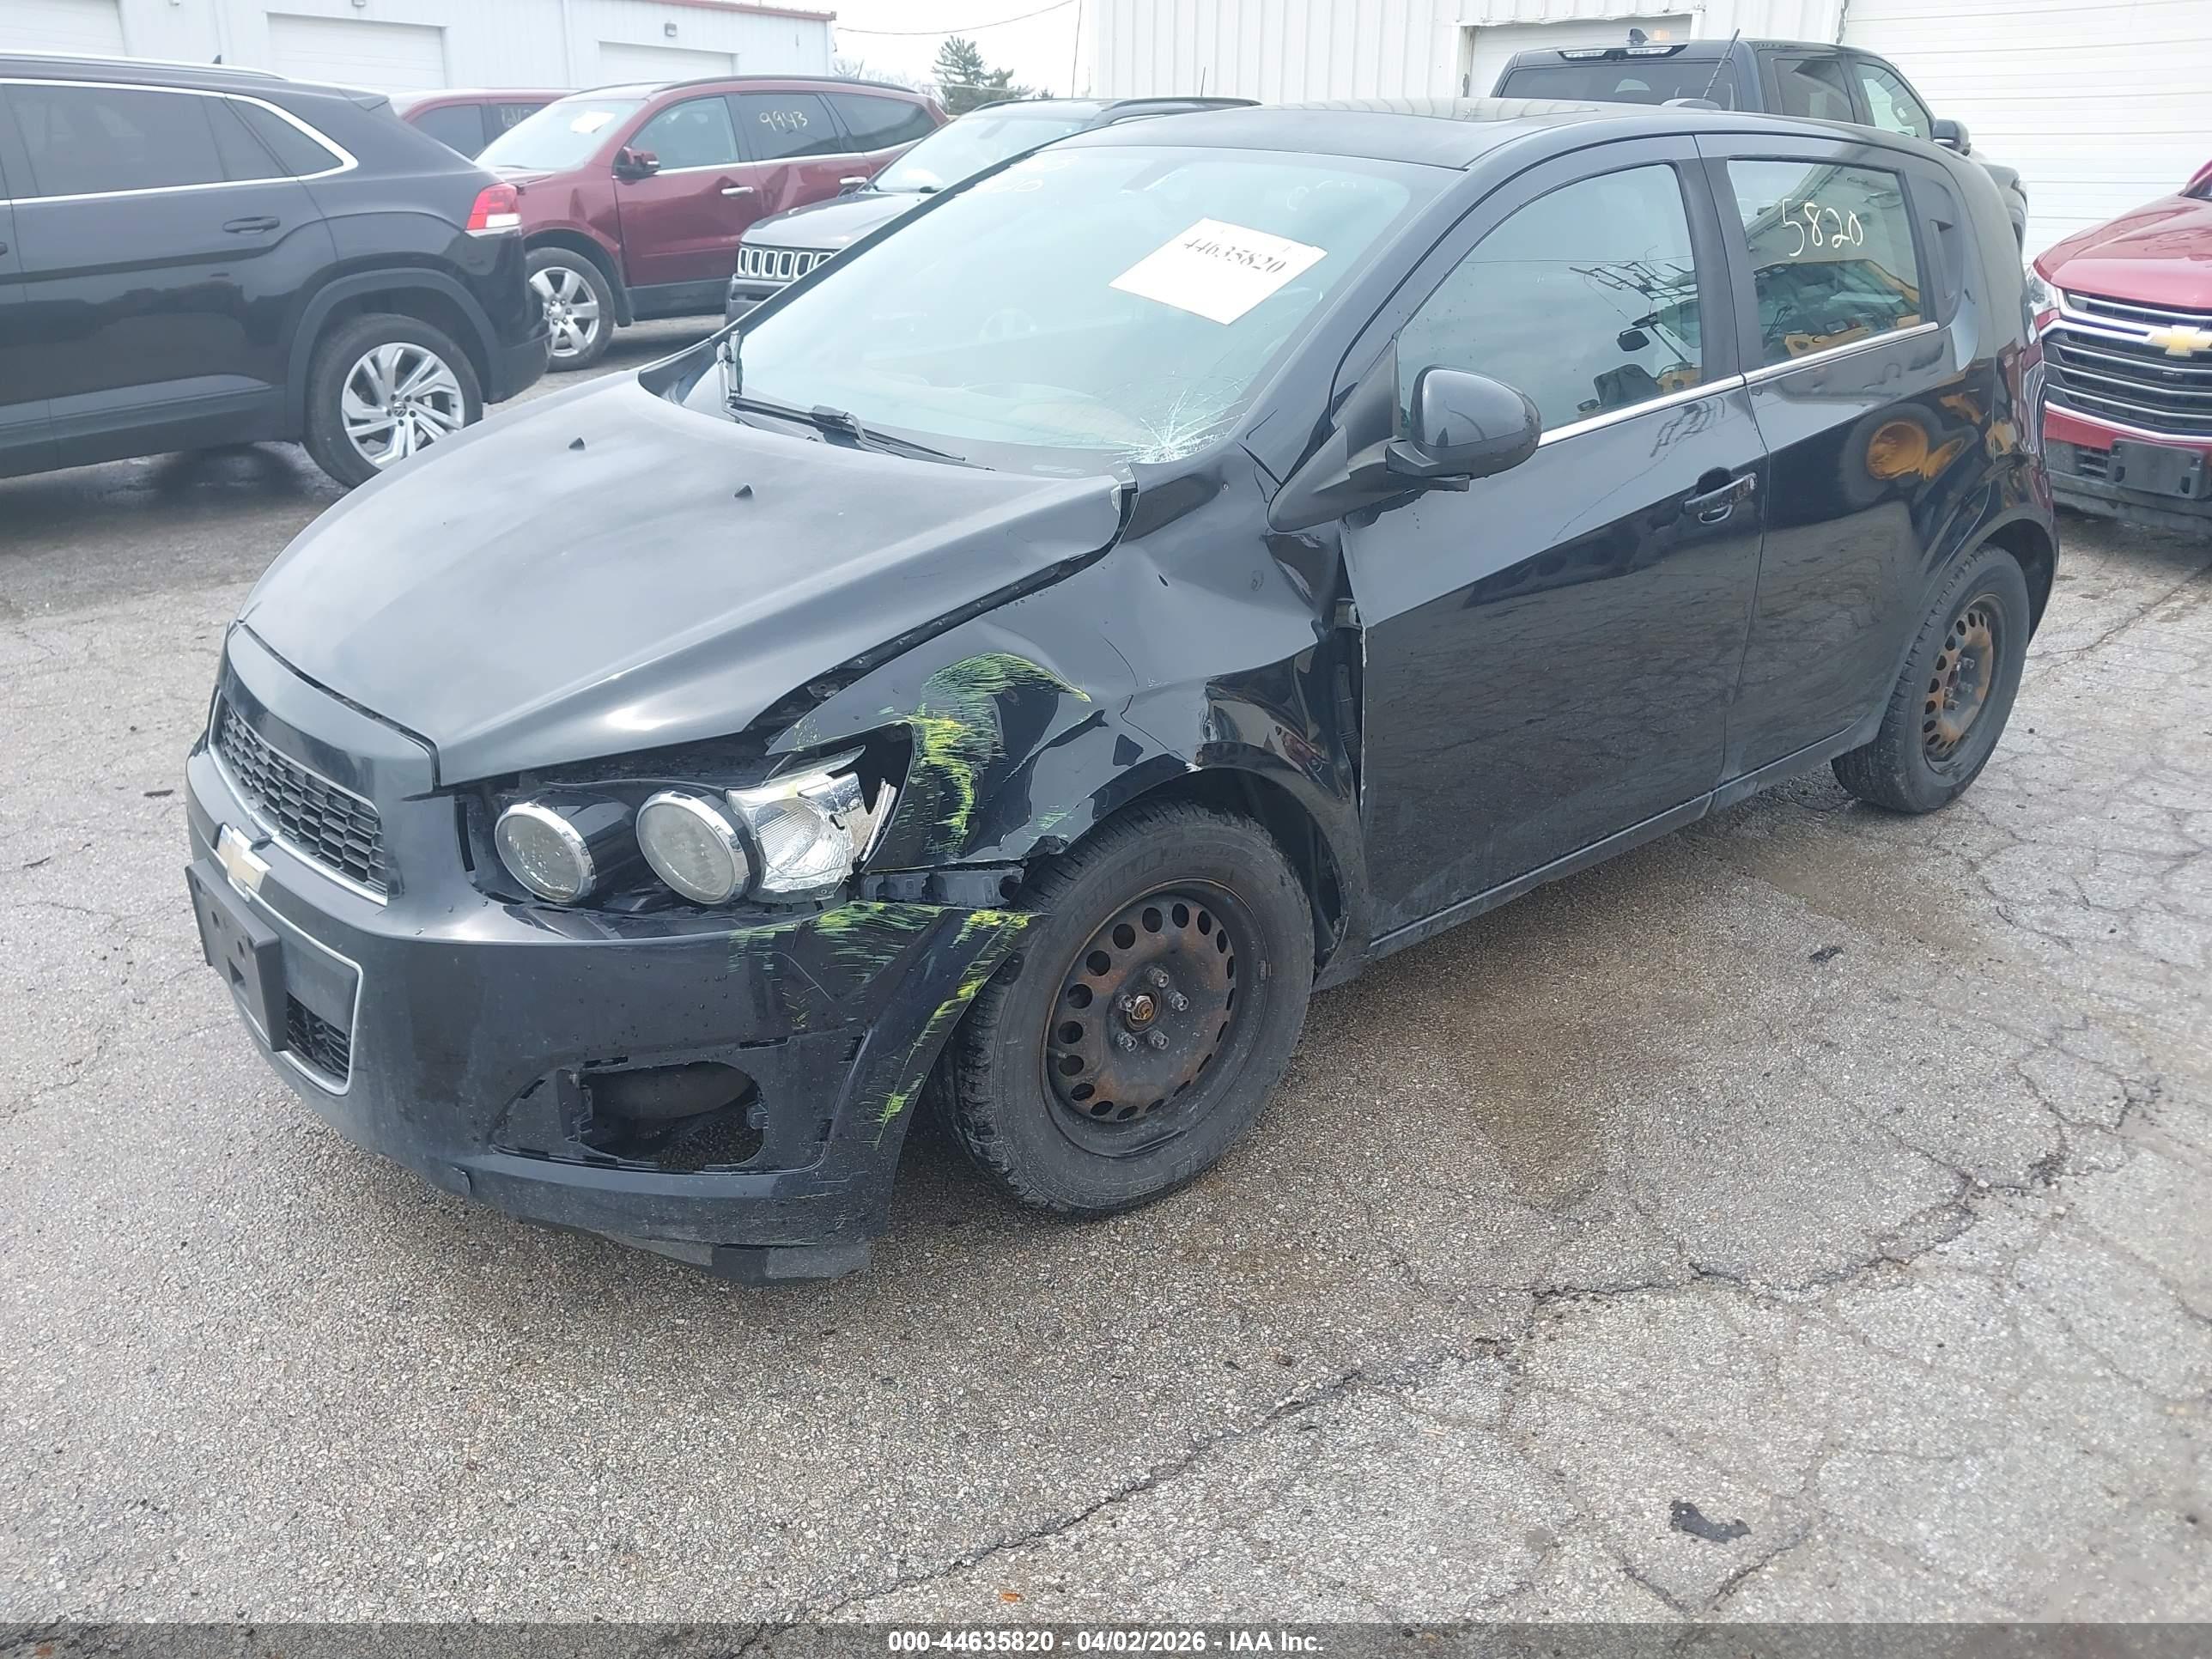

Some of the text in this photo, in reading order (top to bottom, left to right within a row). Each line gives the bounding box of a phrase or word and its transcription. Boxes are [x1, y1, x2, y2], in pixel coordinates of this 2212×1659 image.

[759, 111, 808, 131] 9943
[1782, 198, 1863, 257] 5820
[1183, 238, 1286, 274] 44635820
